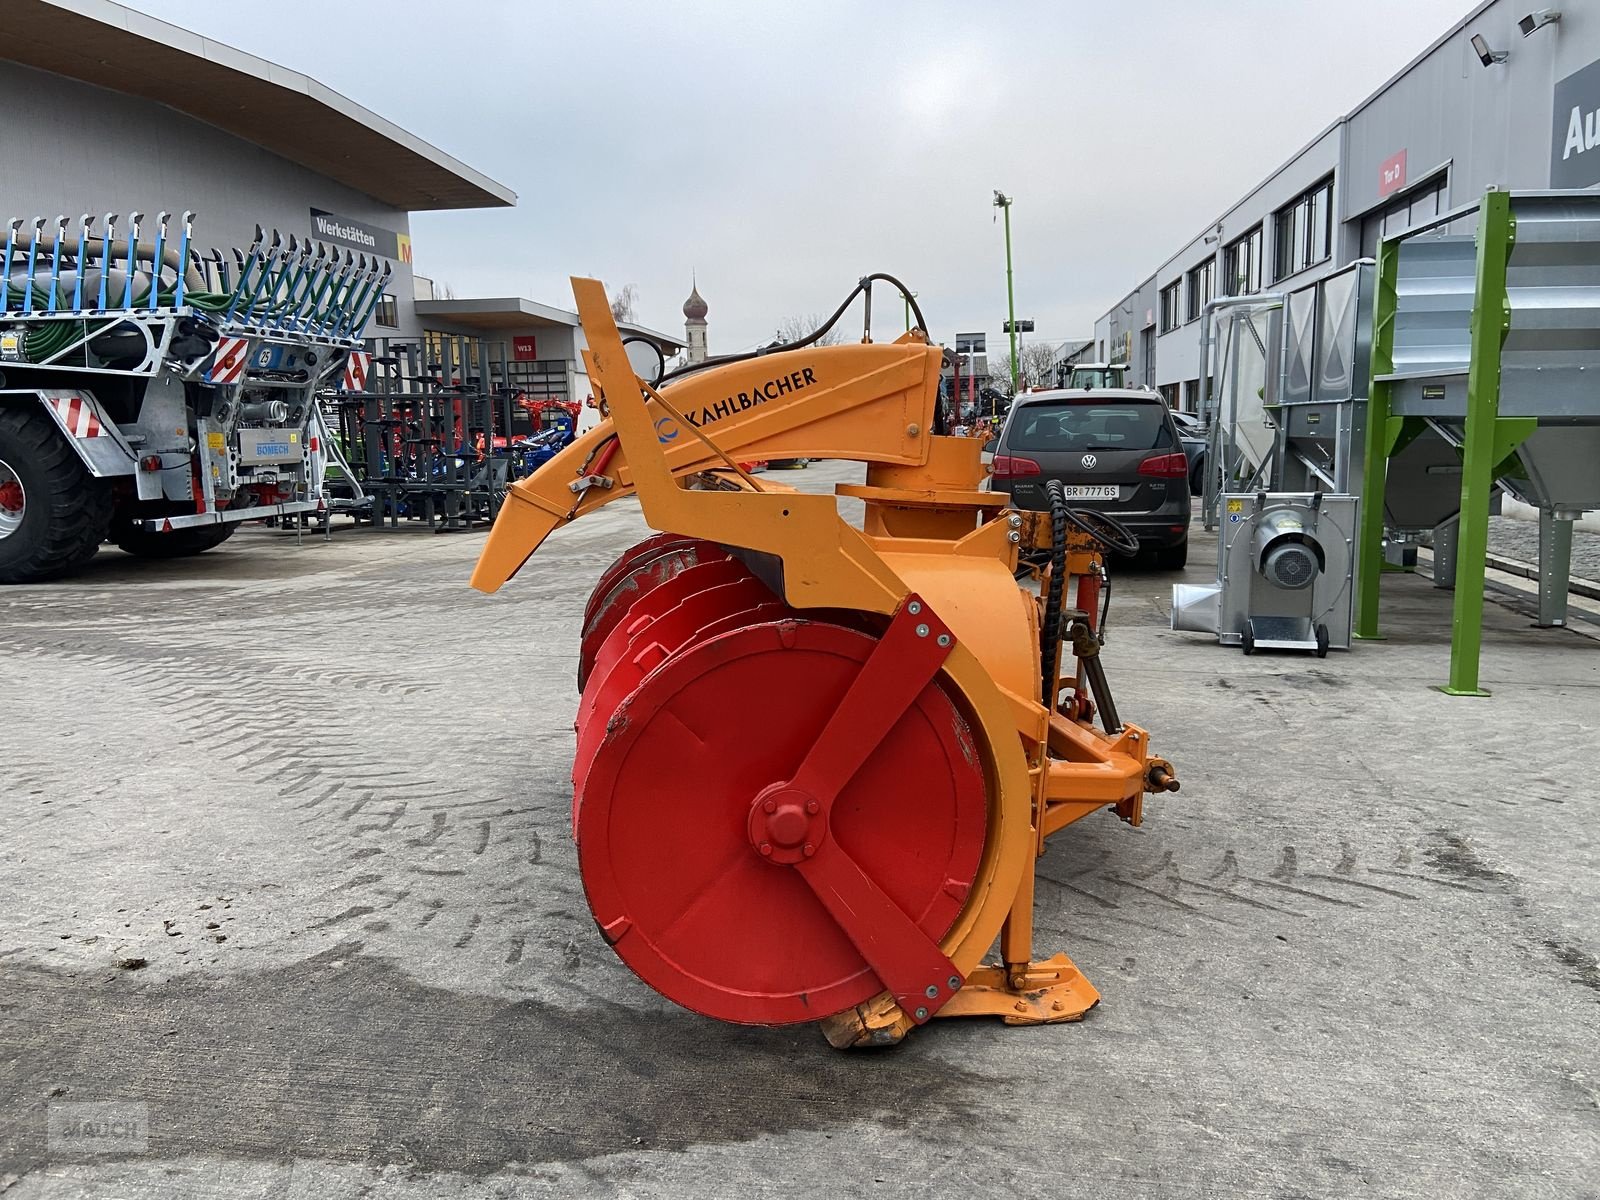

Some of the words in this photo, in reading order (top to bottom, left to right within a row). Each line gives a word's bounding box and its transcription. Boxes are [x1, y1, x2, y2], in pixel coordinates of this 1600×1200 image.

[1384, 170, 1394, 184] Tor
[316, 217, 375, 247] Werkstätten
[260, 351, 270, 363] 25
[684, 367, 817, 428] KAHLBACHER
[256, 444, 289, 456] BOMECH
[1066, 487, 1078, 496] BR
[1084, 487, 1102, 496] 777
[1104, 487, 1116, 496] GS
